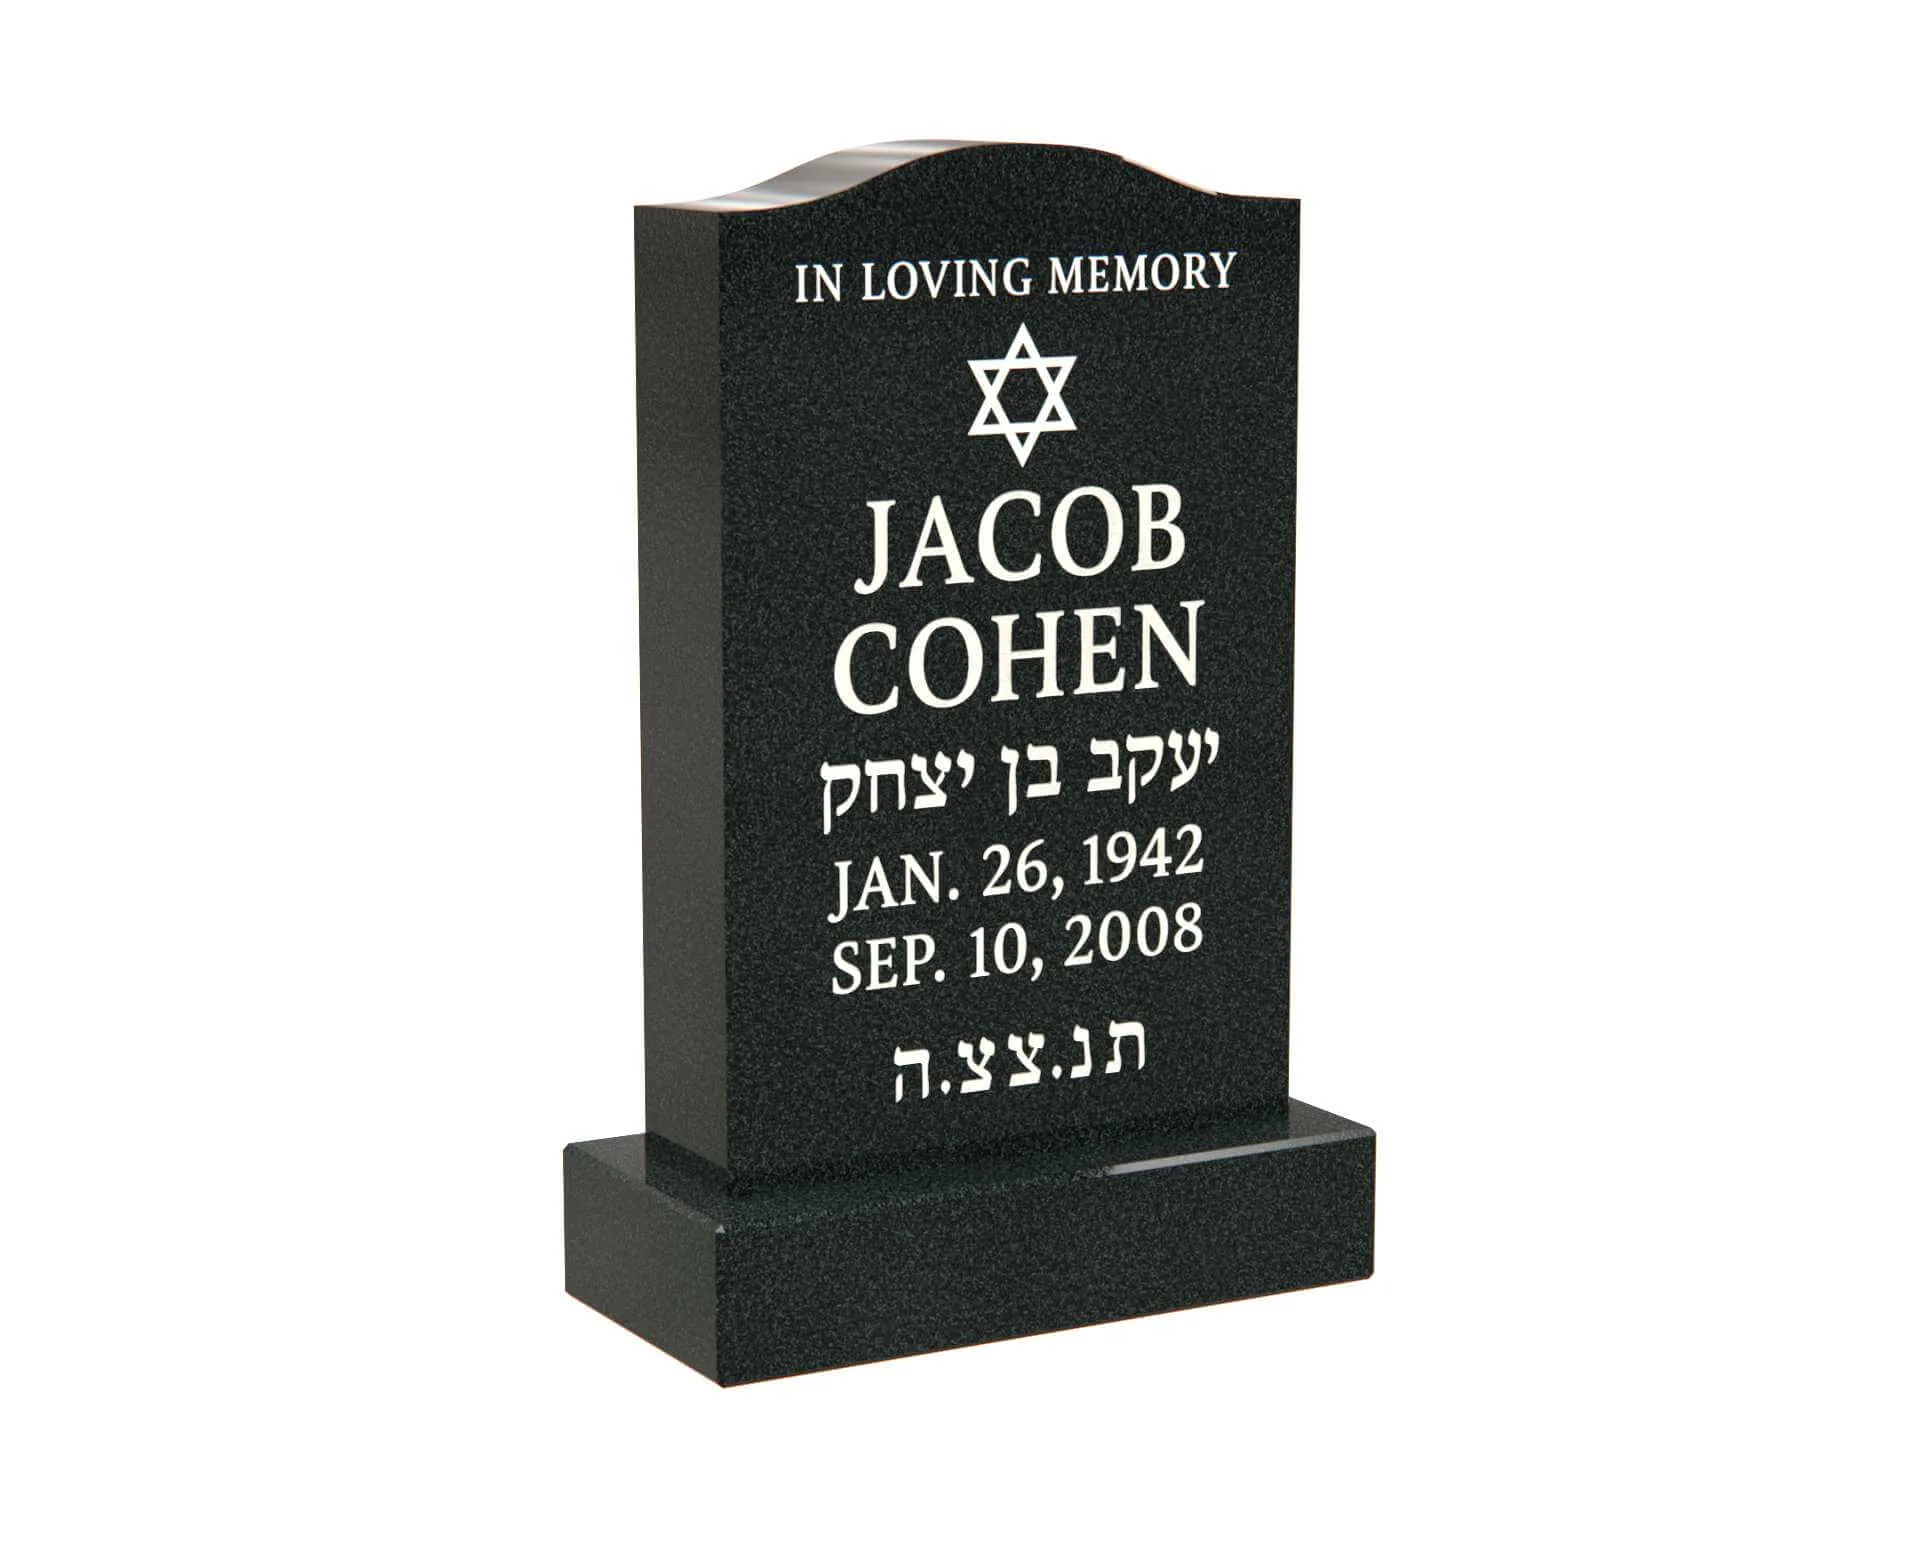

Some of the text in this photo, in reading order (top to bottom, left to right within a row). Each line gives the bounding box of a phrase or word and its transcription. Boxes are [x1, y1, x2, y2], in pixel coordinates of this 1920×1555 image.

[795, 251, 1238, 303] IN LOVING MEMORY
[853, 483, 1186, 595] JACOB
[833, 599, 1206, 715] COHEN
[820, 727, 1220, 835] יעקב בן יצחק
[827, 823, 1204, 924] JAN. 26, 1942
[832, 902, 1203, 995] SEP. 10, 2008
